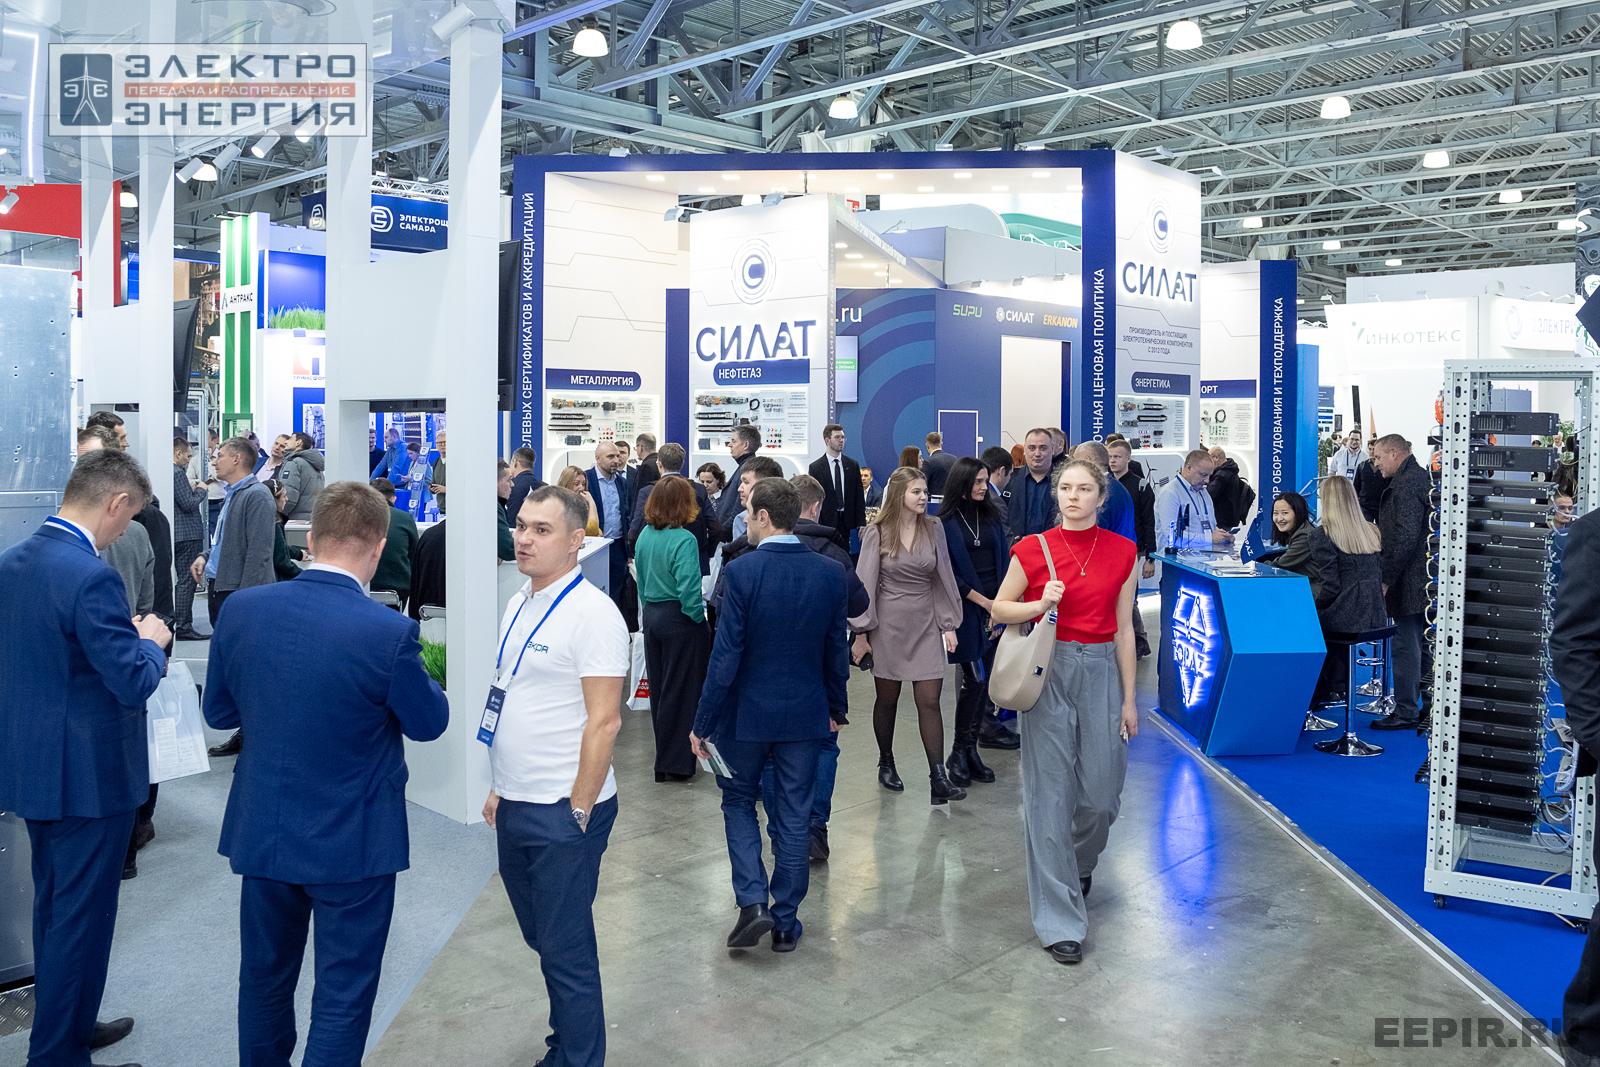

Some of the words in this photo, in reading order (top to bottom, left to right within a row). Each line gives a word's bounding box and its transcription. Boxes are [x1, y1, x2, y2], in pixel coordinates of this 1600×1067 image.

[399, 222, 437, 234] САМАРА
[522, 193, 536, 290] АККРЕДИТАЦИЙ
[1122, 261, 1197, 303] СИЛАТ
[229, 292, 254, 304] АНТРАКС
[522, 292, 533, 301] И
[1093, 268, 1105, 337] ПОЛИТИКА
[952, 304, 982, 318] SUPU
[1005, 310, 1035, 323] СИЛАТ
[1043, 314, 1078, 328] ERKANON
[695, 319, 817, 362] СИЛАТ
[1273, 297, 1285, 386] ТЕХПОДДЕРЖКА
[522, 304, 533, 399] СЕРТИФИКАТОВ
[718, 367, 762, 379] НЕФТЕГАЗ
[1093, 340, 1106, 397] ЦЕНОВАЯ
[570, 375, 634, 386] МЕТАЛЛУРГИЯ
[1135, 377, 1171, 389] ЭНЕРГЕТИКА
[1273, 387, 1283, 395] И
[1272, 397, 1284, 484] ОБОРУДОВАНИЯ
